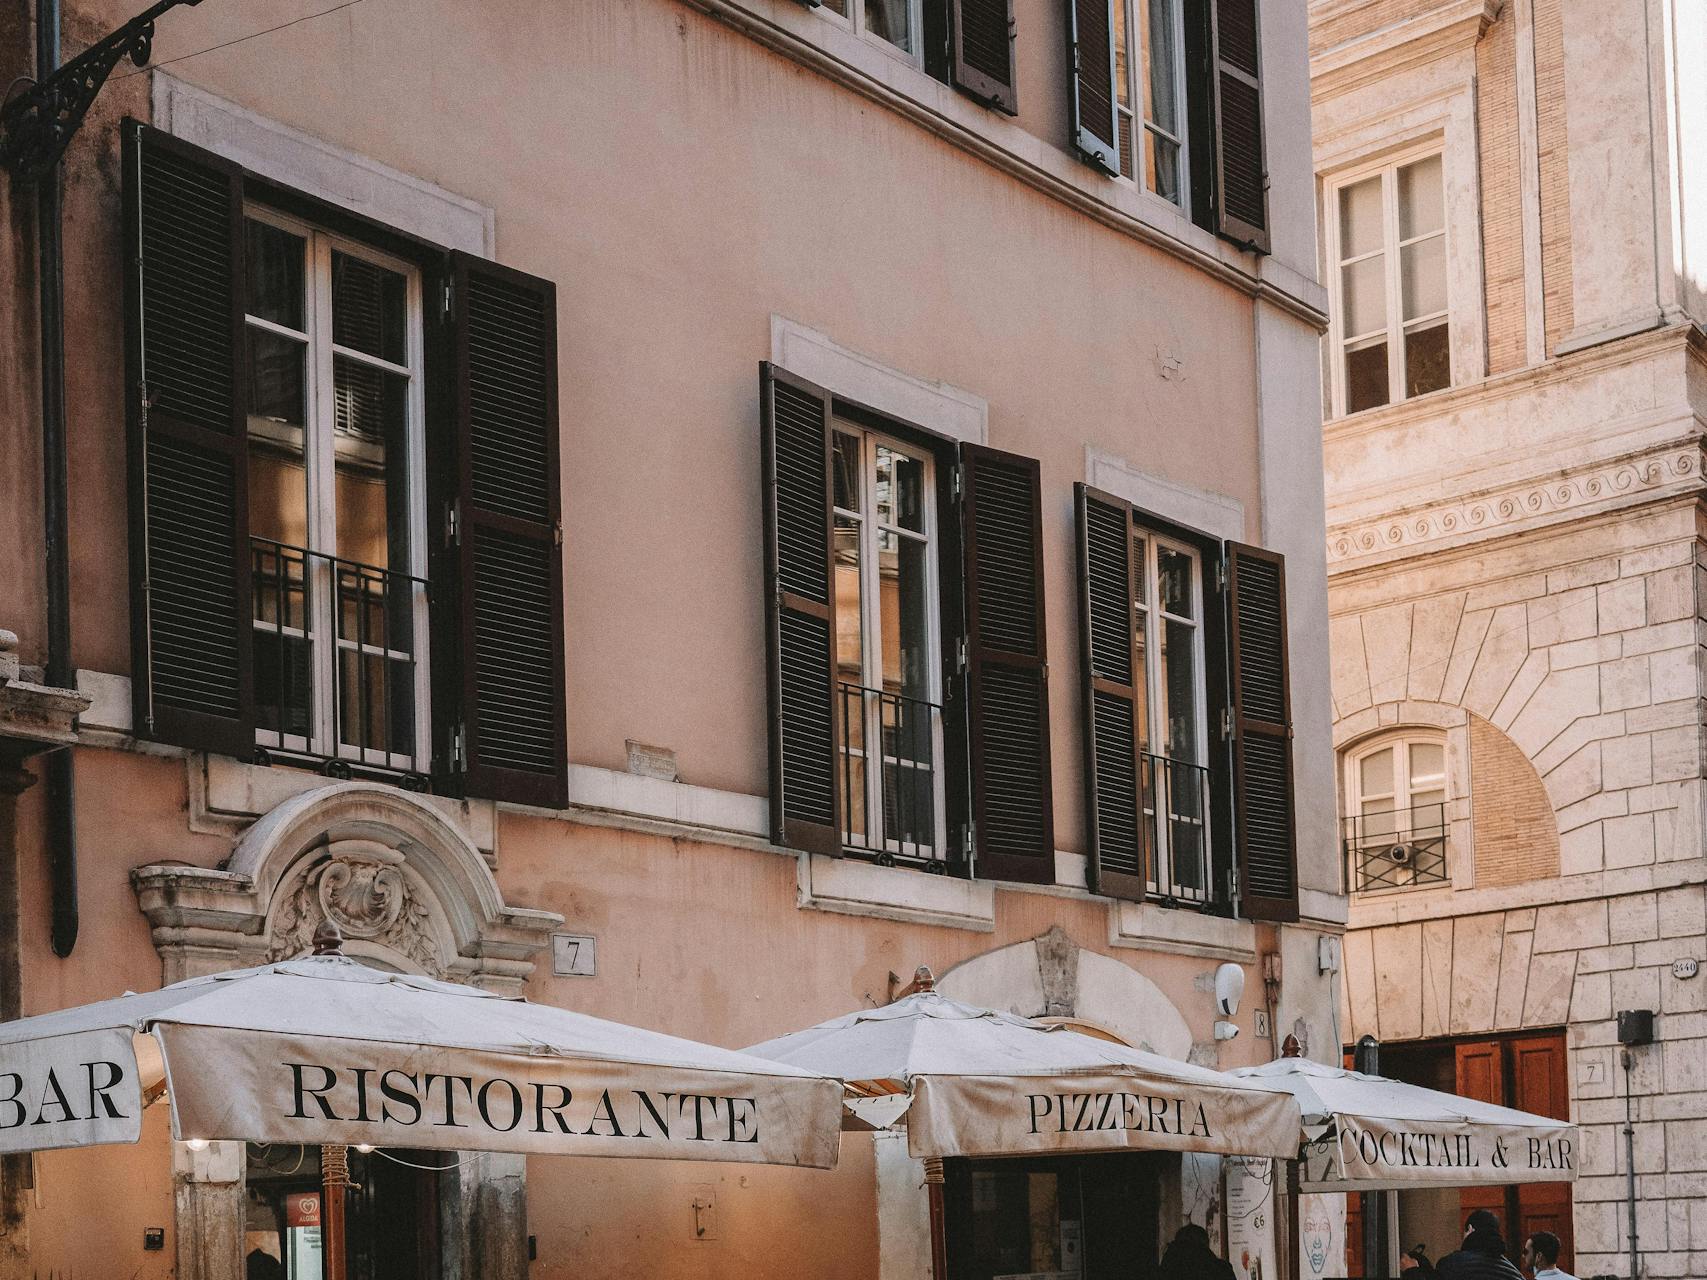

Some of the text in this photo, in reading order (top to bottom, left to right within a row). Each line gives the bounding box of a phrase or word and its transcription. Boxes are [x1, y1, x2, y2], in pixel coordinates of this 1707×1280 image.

[567, 941, 580, 970] 7
[1259, 1013, 1265, 1035] 8
[1587, 1065, 1595, 1080] 7
[0, 1061, 130, 1129] BAR
[284, 1062, 759, 1143] RISTORANTE
[1025, 1093, 1213, 1137] PIZZERIA
[1340, 1128, 1479, 1167] COCKTAIL
[1492, 1136, 1510, 1168] &
[1528, 1137, 1574, 1169] BAR
[1253, 1214, 1265, 1229] €6
